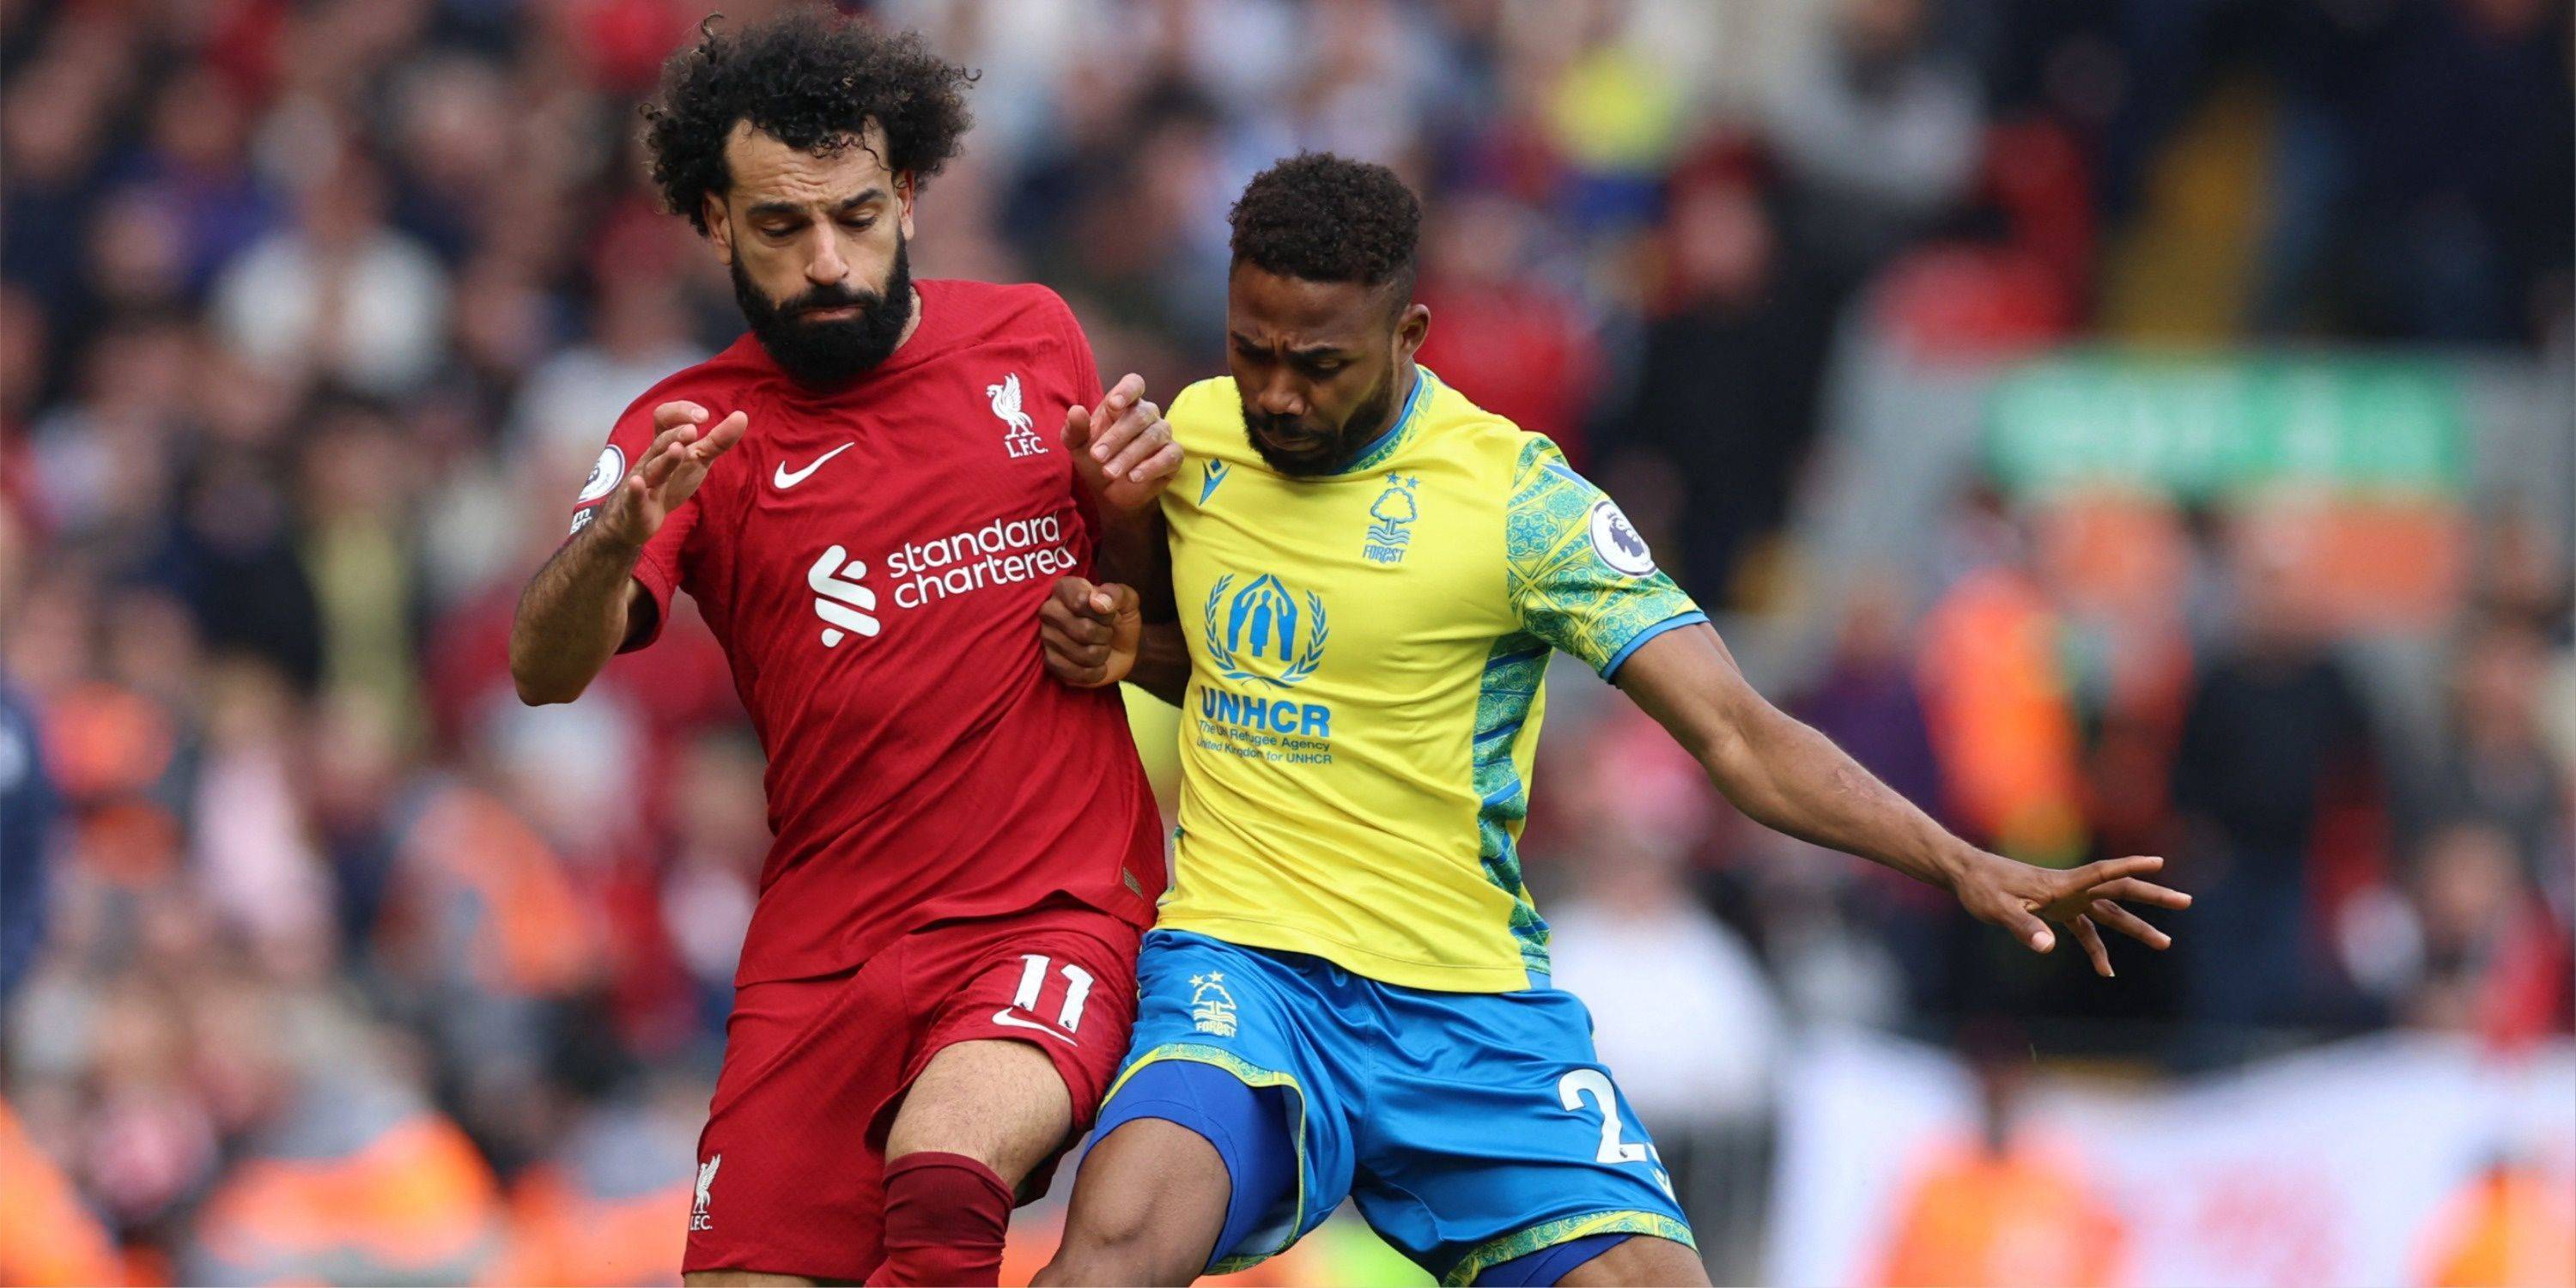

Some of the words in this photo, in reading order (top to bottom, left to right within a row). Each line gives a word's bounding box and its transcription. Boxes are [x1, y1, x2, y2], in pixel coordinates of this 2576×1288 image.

[887, 511, 1060, 579] standard
[1363, 544, 1405, 563] FOREST
[895, 541, 1078, 609] chartered
[1200, 685, 1331, 738] UNHCR
[1200, 720, 1216, 735] The
[1230, 728, 1277, 747] Refugee
[1282, 737, 1330, 752] Agency
[1197, 735, 1224, 751] United
[1267, 751, 1283, 762] for
[1285, 752, 1333, 764] UNHCR
[1013, 954, 1095, 1034] 11
[1195, 1020, 1236, 1038] FOREST
[1558, 1068, 1663, 1165] 2
